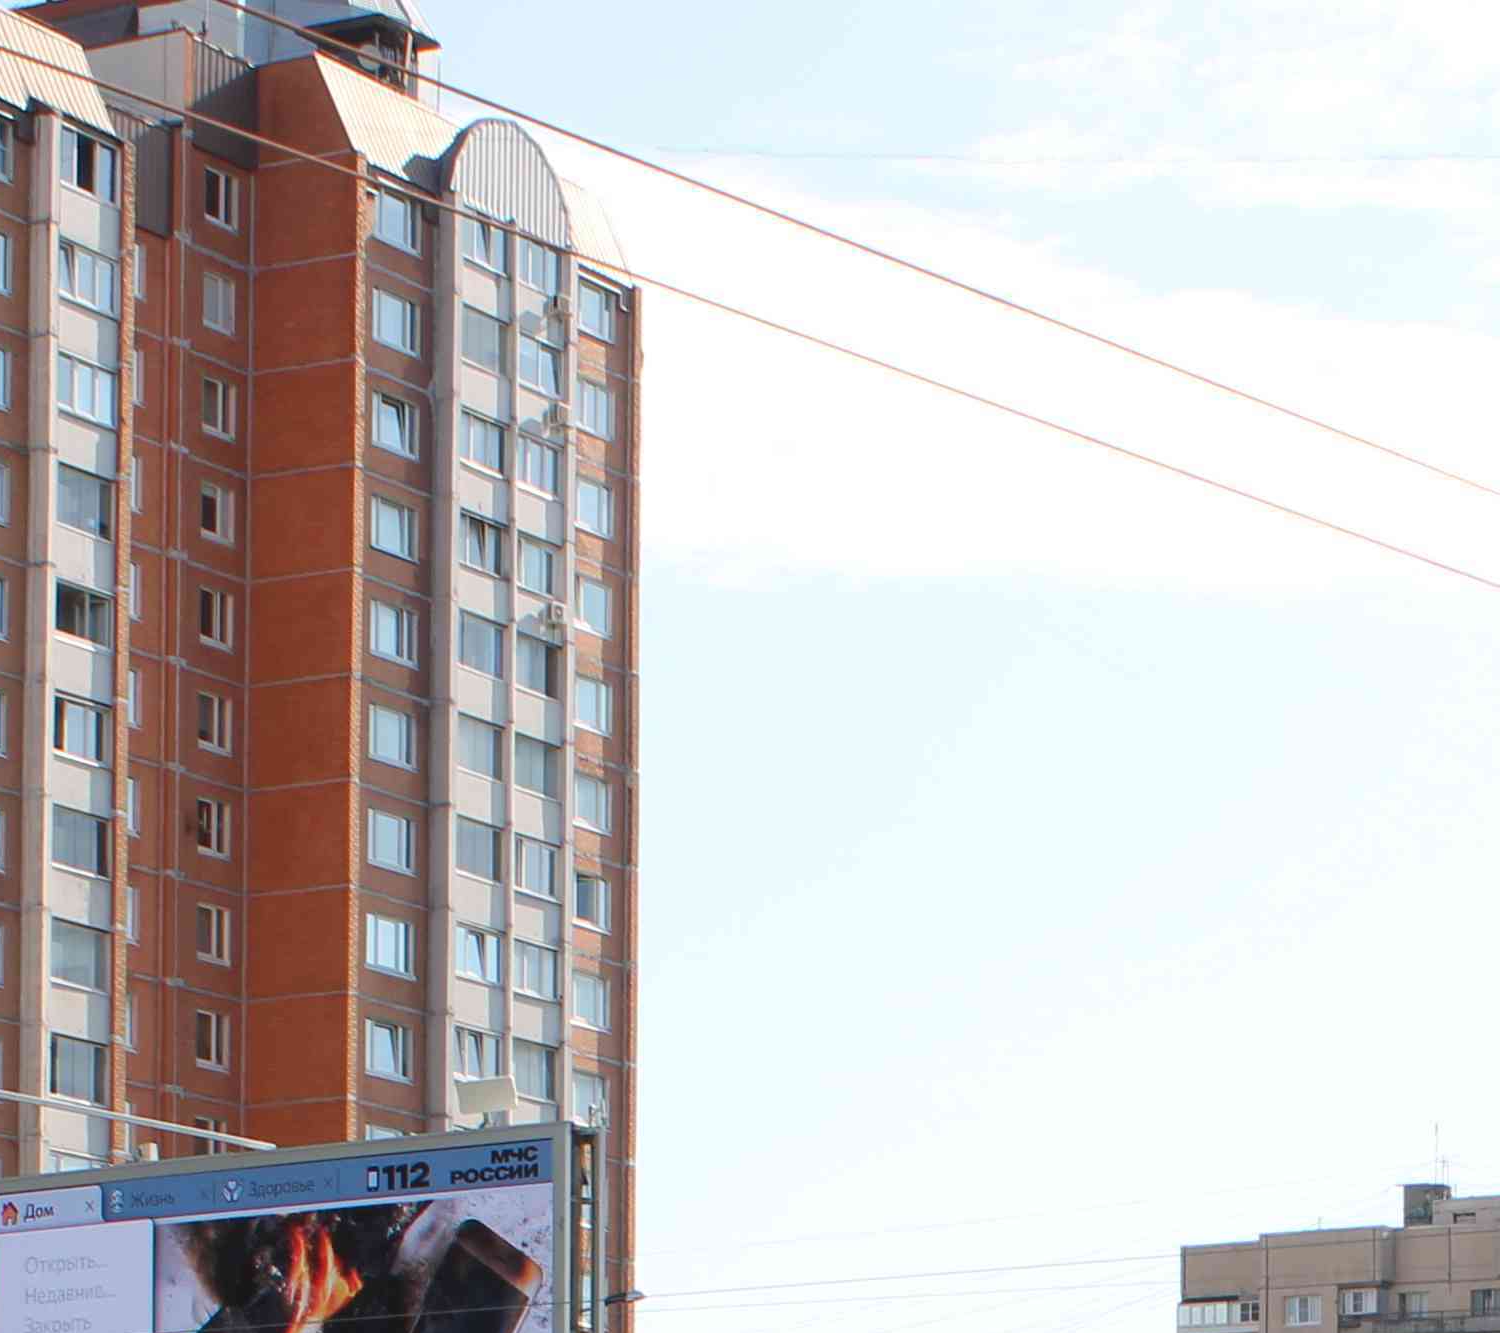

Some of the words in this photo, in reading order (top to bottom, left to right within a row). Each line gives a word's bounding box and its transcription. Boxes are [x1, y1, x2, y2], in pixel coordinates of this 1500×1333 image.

[491, 1146, 539, 1165] МЧС
[381, 1163, 431, 1190] 112
[450, 1162, 540, 1184] РОССИИ
[249, 1176, 315, 1200] Здоровье
[23, 1202, 55, 1222] Дом
